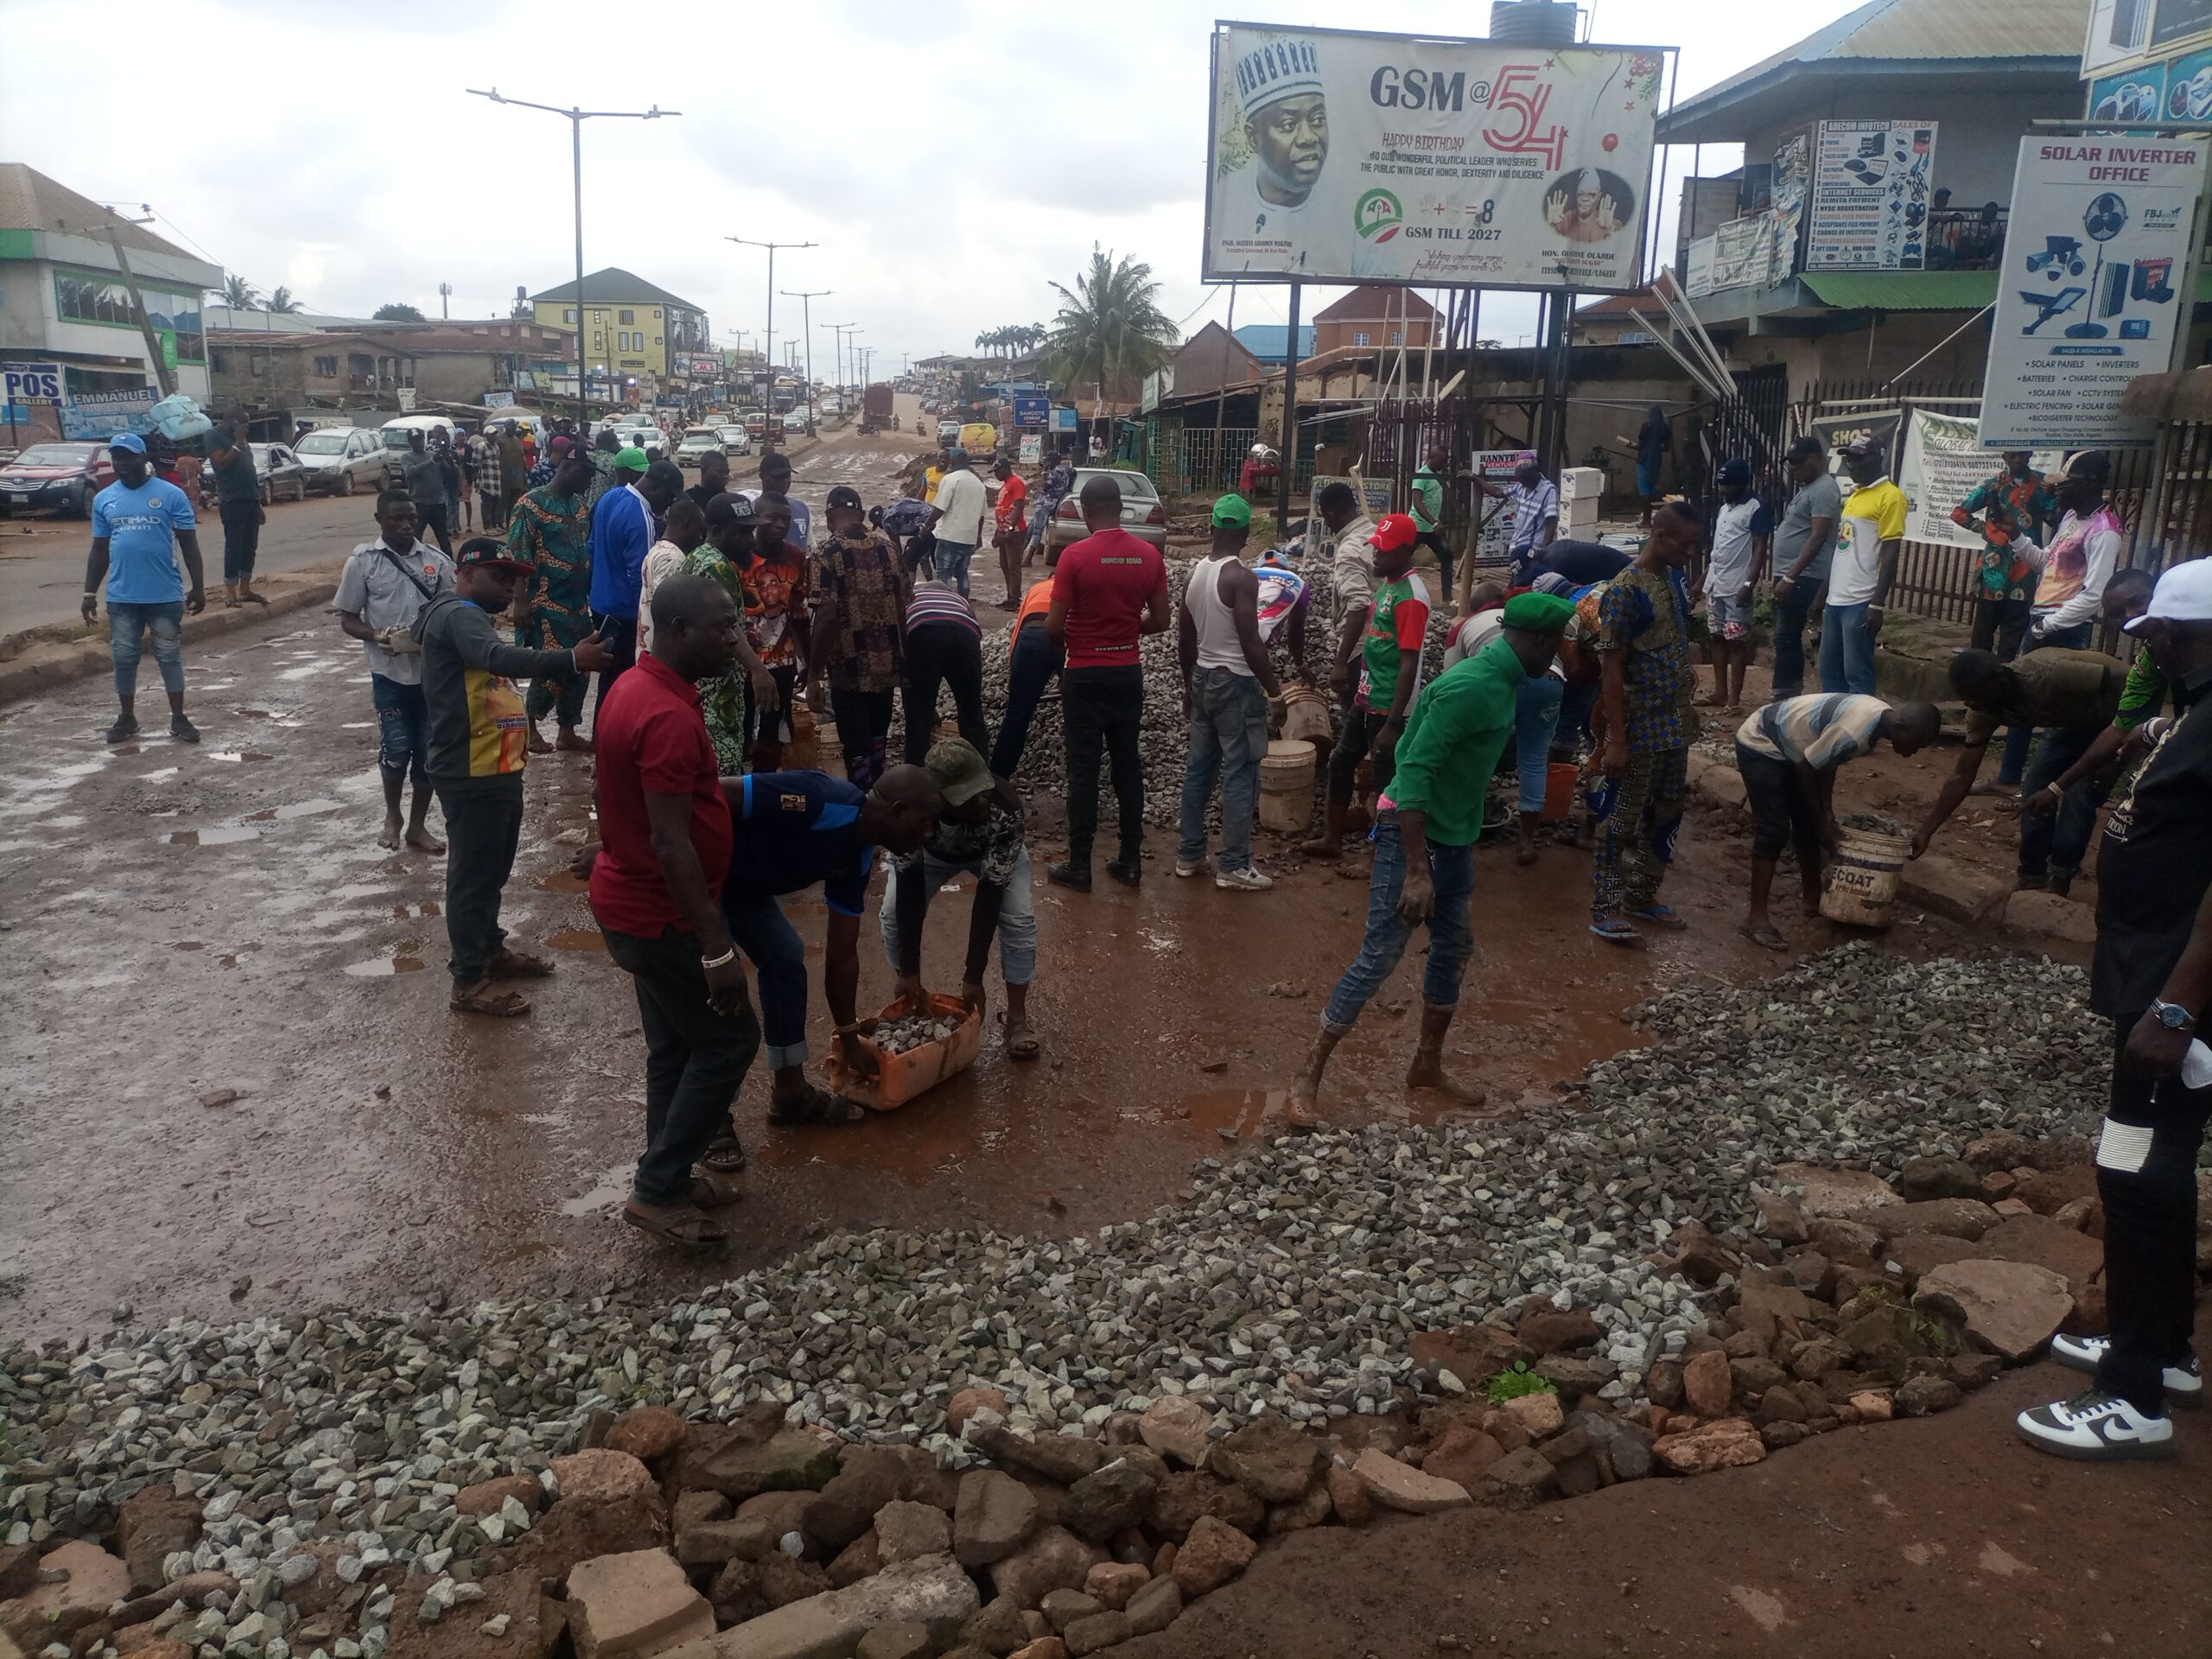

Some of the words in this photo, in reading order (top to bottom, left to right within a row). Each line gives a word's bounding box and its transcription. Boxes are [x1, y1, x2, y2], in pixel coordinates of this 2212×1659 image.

[1370, 66, 1466, 111] GSM
[1858, 121, 1890, 131] INFOTECH
[1382, 132, 1414, 149] HAPPY
[1415, 134, 1465, 151] BIRTHDAY
[1396, 152, 1434, 164] WONDERFUL
[1435, 154, 1467, 166] POLITICAL
[1469, 156, 1495, 166] LEADER
[1496, 156, 1511, 167] WHO
[1512, 157, 1537, 168] SERVES
[2040, 145, 2102, 162] SOLAR
[2107, 148, 2196, 165] INVERTER
[1361, 162, 1372, 173] THE
[1373, 163, 1395, 175] PUBLIC
[1396, 164, 1414, 175] WITH
[1414, 166, 1434, 176] GREAT
[1436, 167, 1459, 178] HONOR,
[1461, 168, 1497, 179] DEXTERITY
[1497, 168, 1511, 179] AND
[1512, 168, 1544, 180] DILIGENCE
[2088, 166, 2150, 182] OFFICE
[1482, 199, 1495, 224] 8
[1405, 226, 1433, 239] GSM
[1437, 227, 1464, 240] TILL
[1467, 229, 1502, 241] 2027
[2031, 360, 2056, 369] SOLAR
[2056, 360, 2085, 369] PANELS
[2101, 360, 2140, 369] INVERTERS
[5, 373, 59, 398] POS
[2022, 374, 2056, 383] BATTERIES
[73, 389, 156, 404] EMMANUEL
[2032, 389, 2056, 397] SOLAR
[2056, 389, 2071, 397] FAN
[2082, 389, 2101, 397] CCTV
[2009, 402, 2041, 410] ELECTRIC
[2042, 402, 2073, 410] FENCING
[2082, 402, 2105, 410] SOLAR
[2032, 414, 2074, 423] BIODIGESTER
[2074, 414, 2118, 423] TECHNOLOGY
[1363, 481, 1392, 490] STORE
[110, 516, 161, 525] ETIHAD
